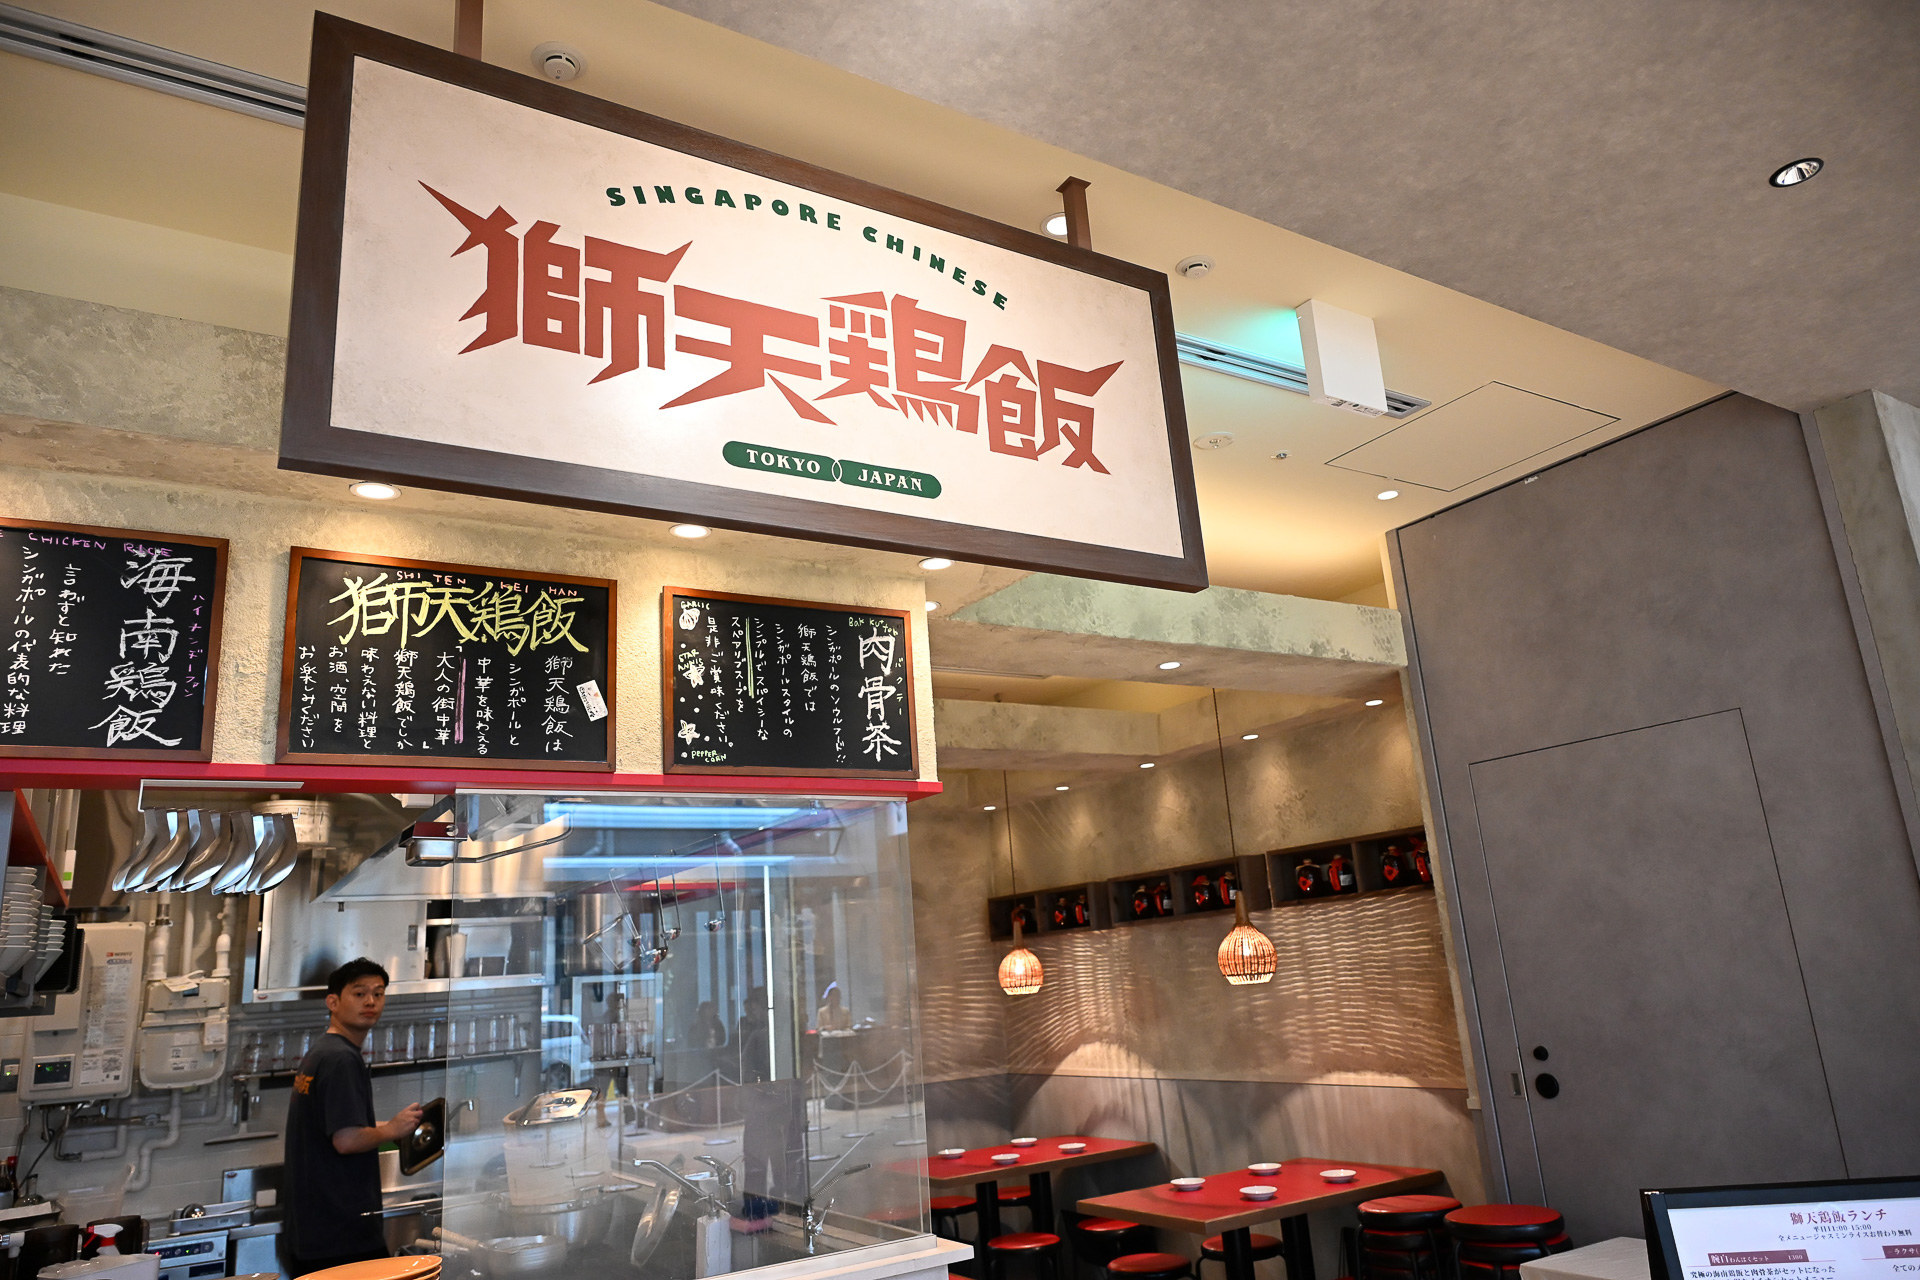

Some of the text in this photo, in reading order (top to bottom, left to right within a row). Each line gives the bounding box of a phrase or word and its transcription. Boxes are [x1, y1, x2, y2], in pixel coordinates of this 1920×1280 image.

[606, 185, 1008, 311] SINGAPORE CHINESE
[418, 180, 1124, 475] 獅天鶏飯
[746, 448, 923, 492] TOKYO JAPAN
[28, 532, 107, 550] CHICKEN
[396, 570, 421, 580] SHI
[433, 574, 467, 585] TEN
[549, 586, 578, 597] HAN
[48, 563, 85, 675] 言わずと知れた
[88, 547, 196, 747] 海南鶏飯
[328, 573, 589, 656] 獅天鶏飯
[678, 648, 700, 663] STAR
[299, 645, 320, 748] お楽しみください
[358, 647, 380, 749] 味わえない料理と
[392, 648, 418, 750] 獅天鶏飯でしか
[475, 657, 495, 755] 中華を味わえる
[507, 663, 527, 746] シンガポールと
[541, 655, 573, 753] 獅天鶏飯は
[731, 616, 747, 713] スペアリブスープを
[754, 617, 769, 741] シンプルでスパイシーな
[775, 623, 795, 738] シンガポールスタイルの
[797, 623, 819, 712] 獅天鶏飯では
[858, 625, 902, 763] 肉骨茶
[895, 657, 904, 716] バクテー
